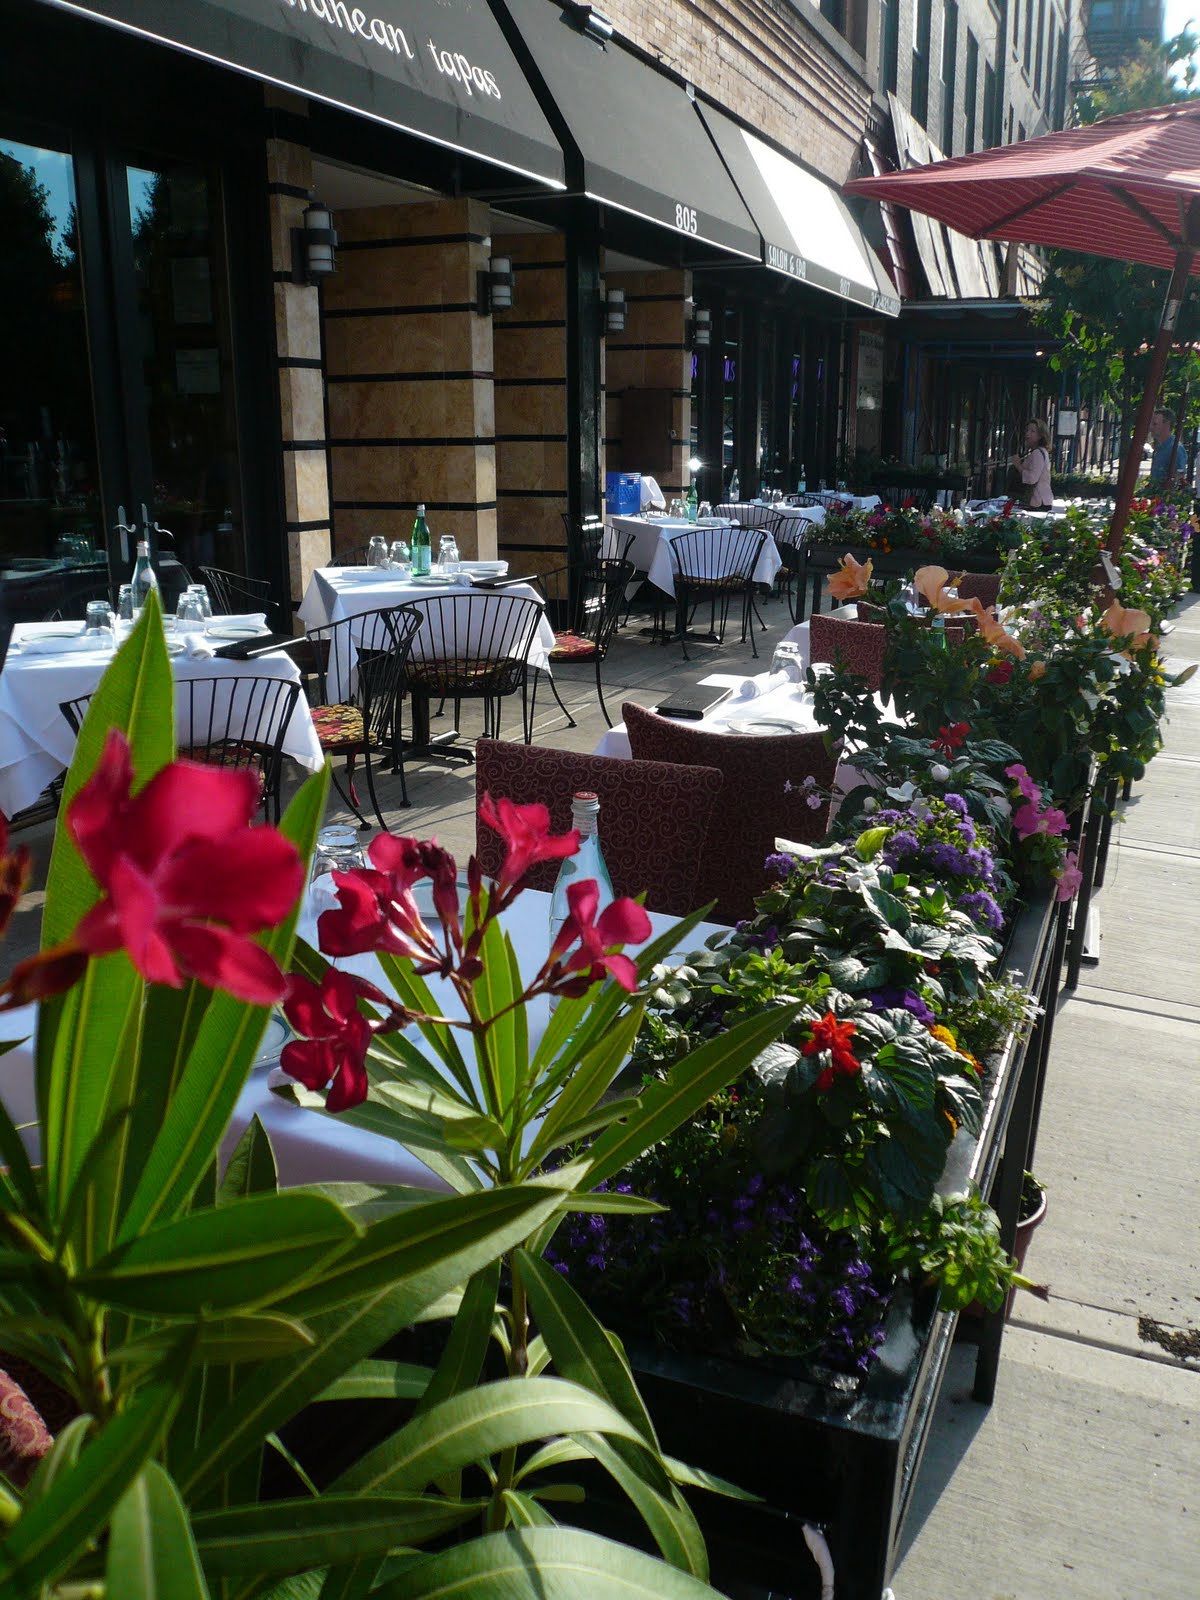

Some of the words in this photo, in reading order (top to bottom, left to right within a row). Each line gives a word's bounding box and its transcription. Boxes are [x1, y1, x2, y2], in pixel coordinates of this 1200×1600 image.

[427, 38, 501, 99] tapas
[675, 203, 698, 234] 805
[768, 245, 788, 271] SALON
[789, 254, 795, 274] &
[796, 257, 806, 279] SPA
